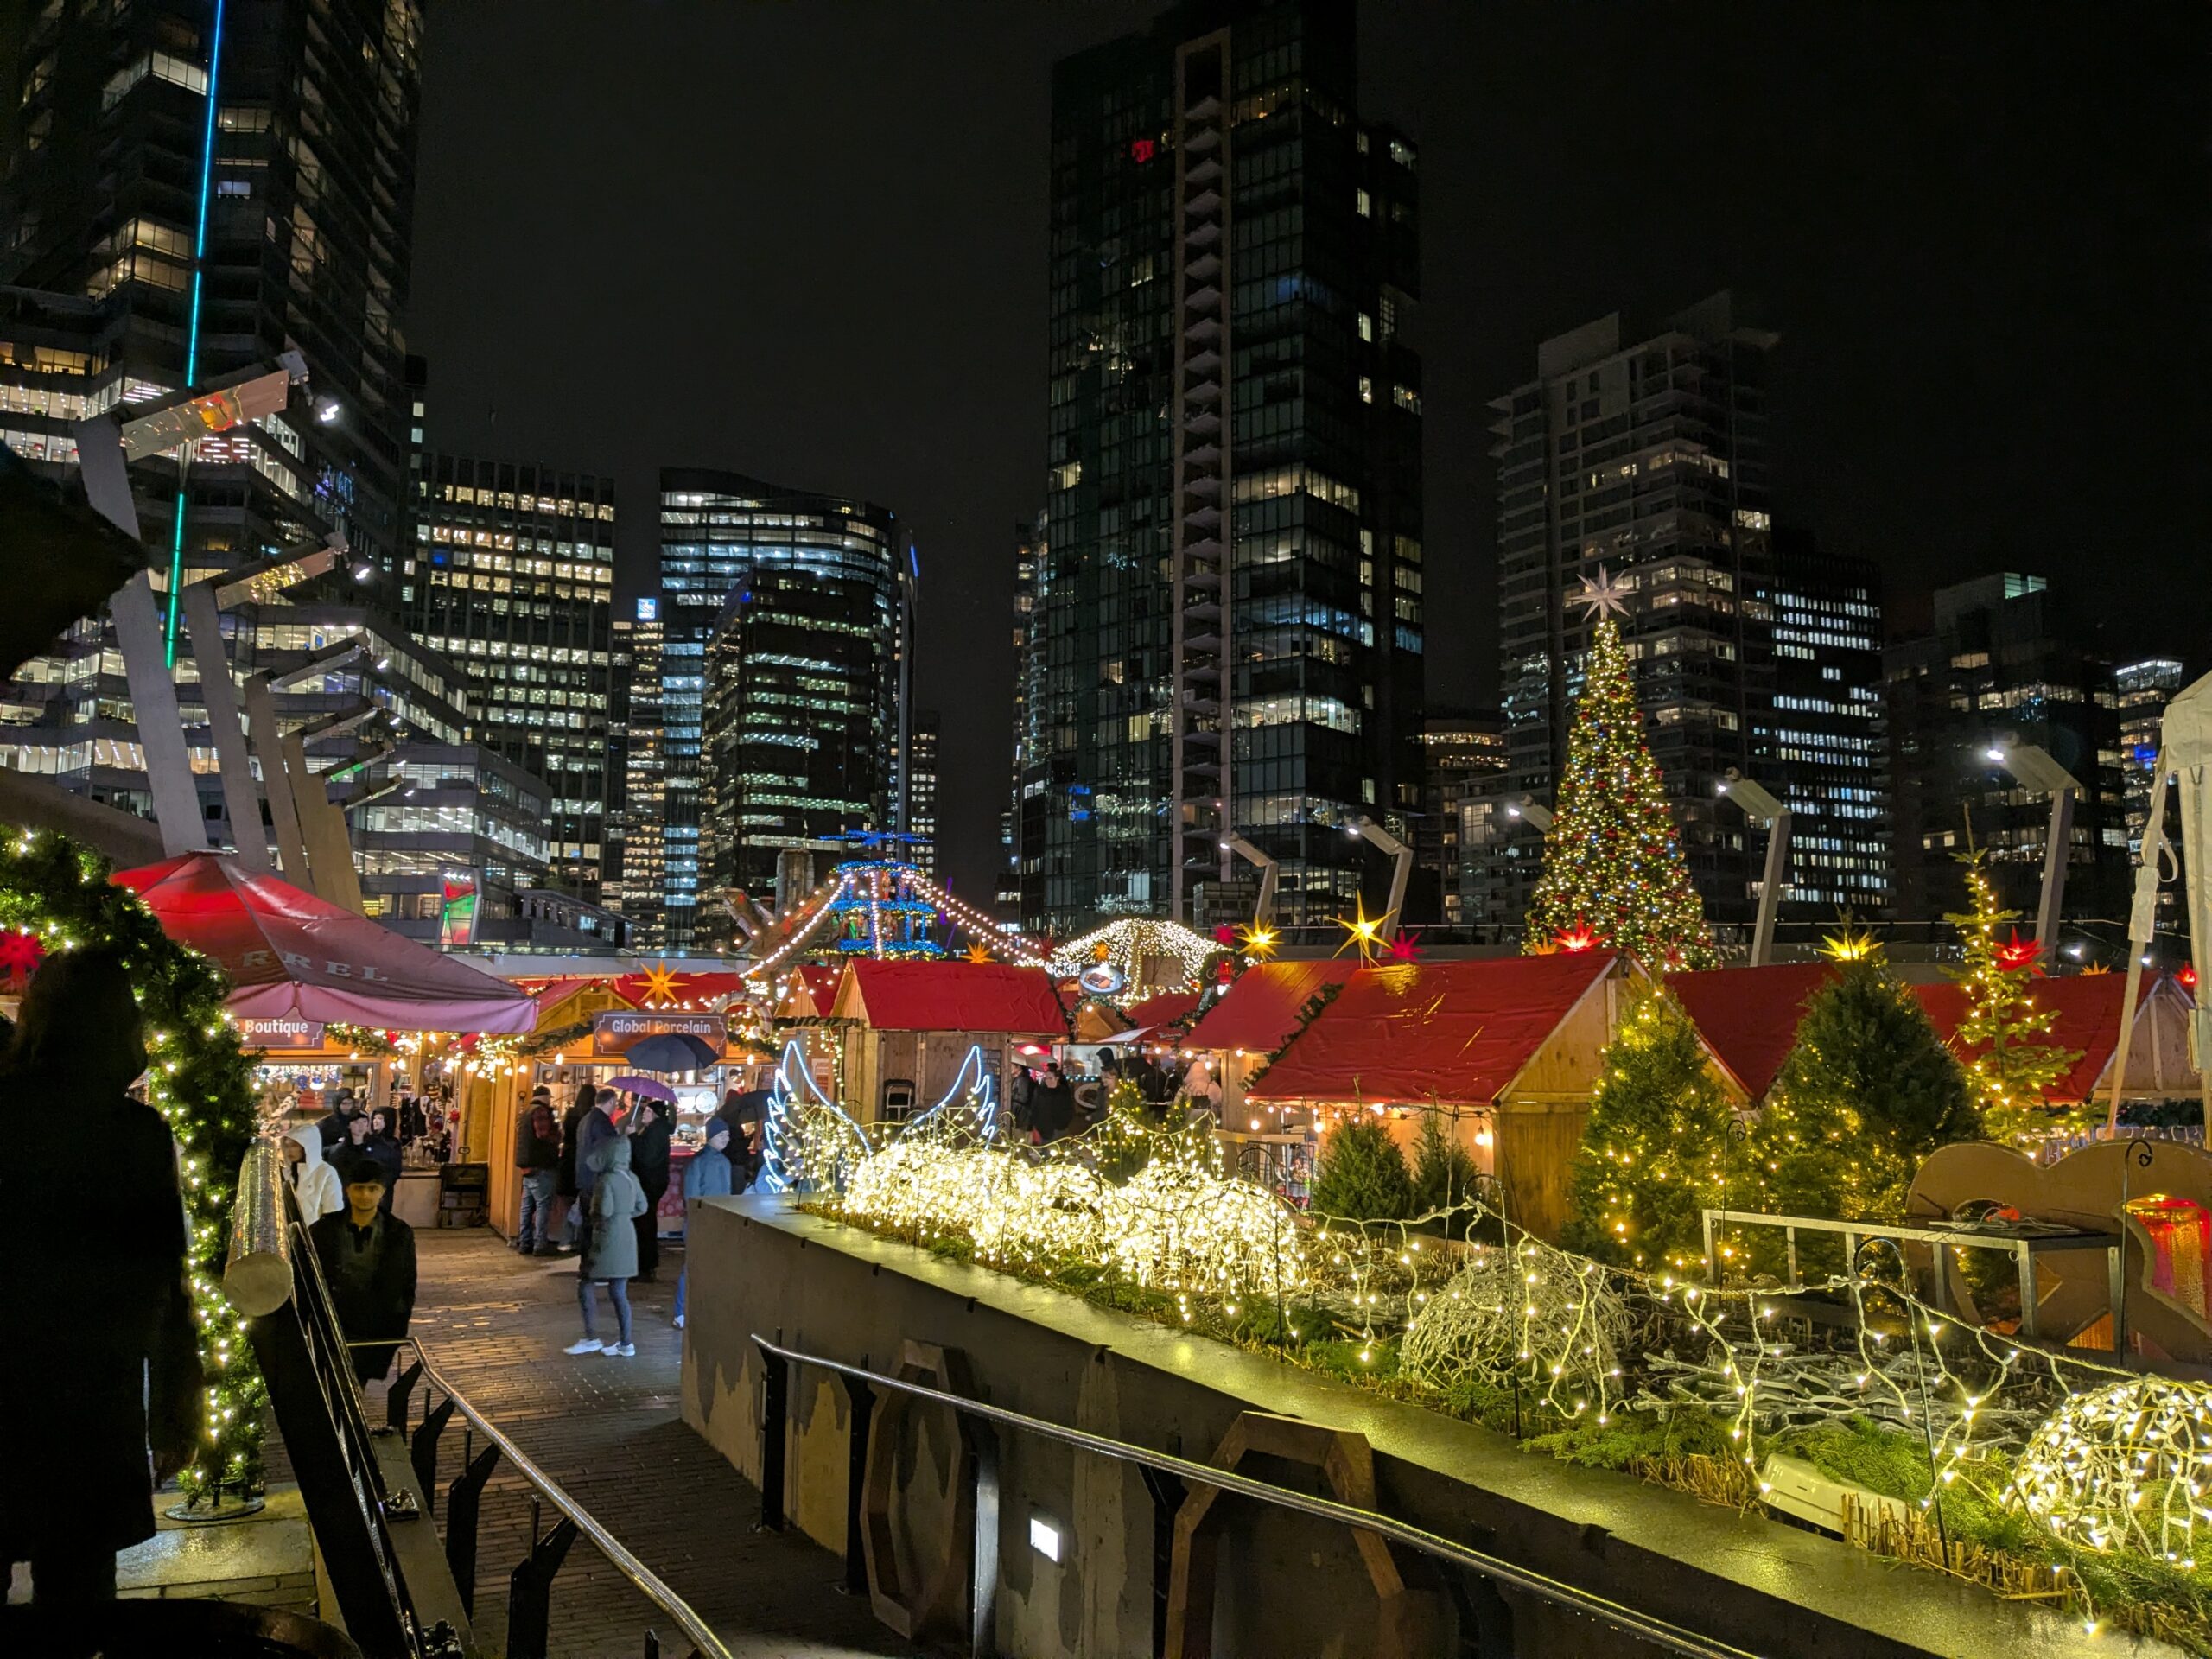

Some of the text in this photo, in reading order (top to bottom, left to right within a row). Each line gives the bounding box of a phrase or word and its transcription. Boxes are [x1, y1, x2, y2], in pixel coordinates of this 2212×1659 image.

[245, 1019, 308, 1037] Boutique
[612, 1019, 711, 1034] Global Porcelain
